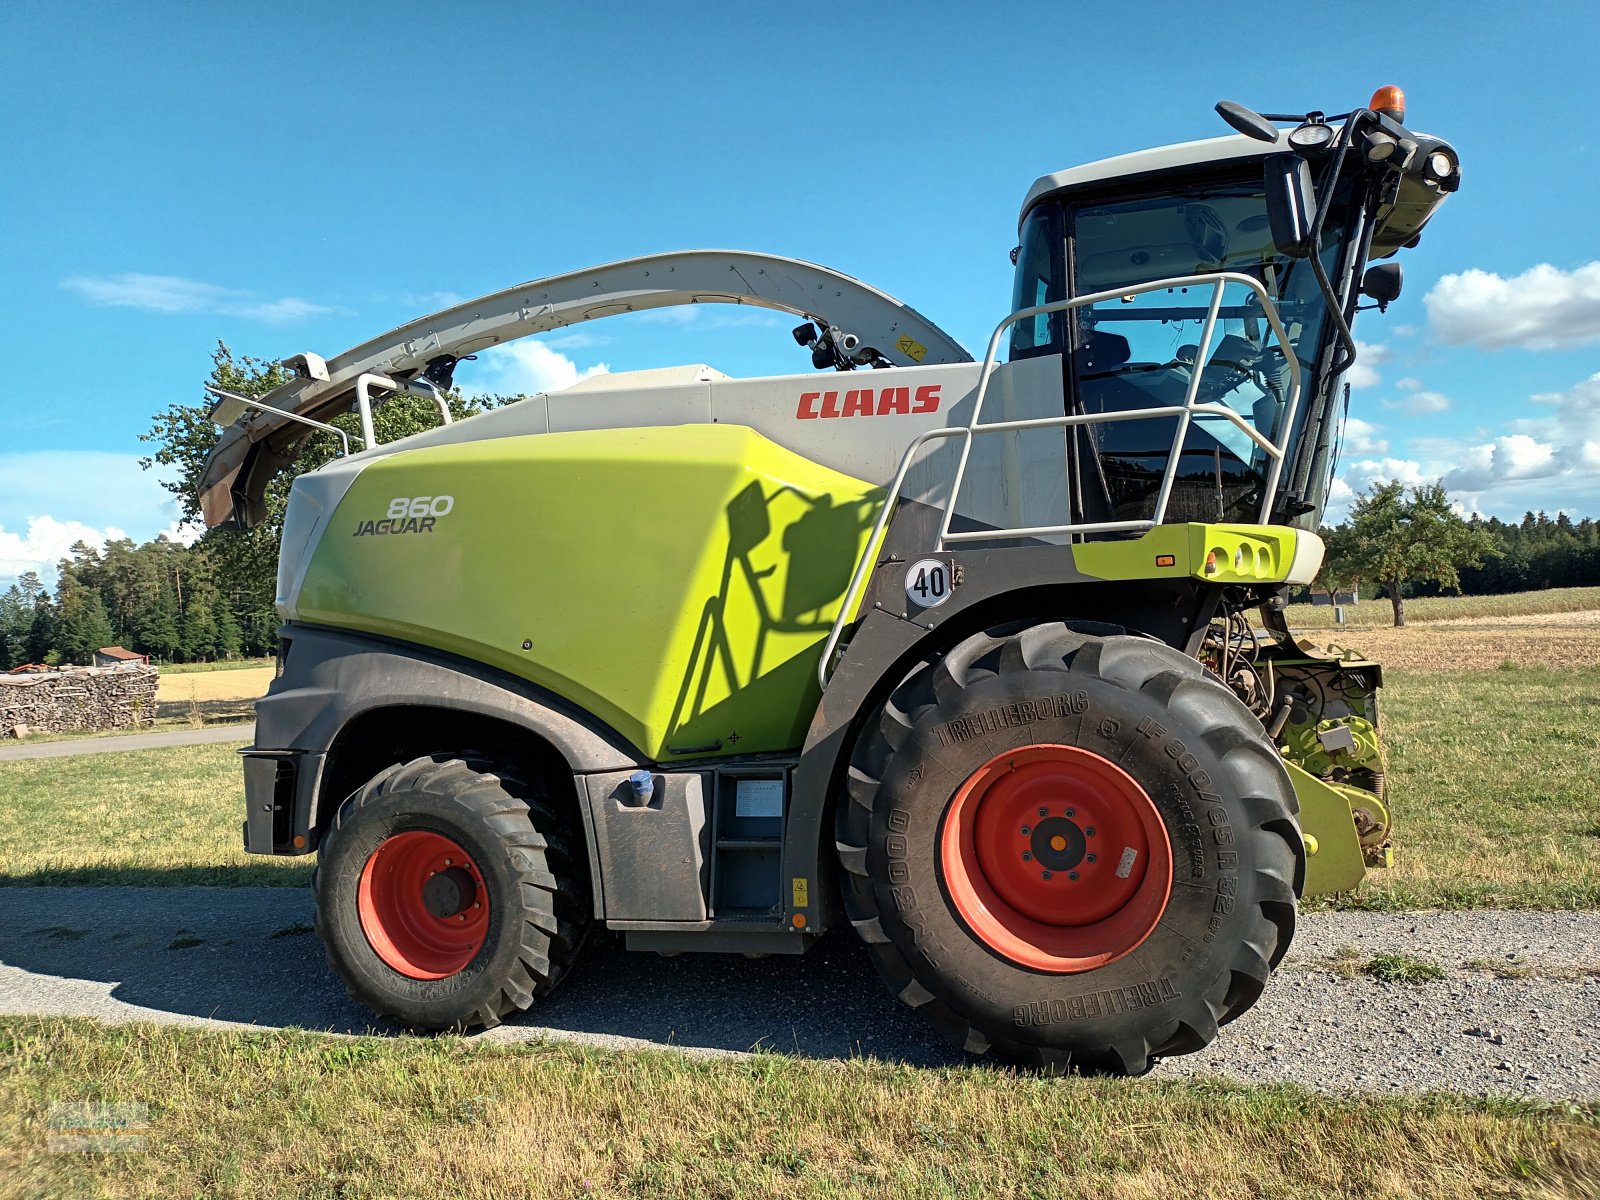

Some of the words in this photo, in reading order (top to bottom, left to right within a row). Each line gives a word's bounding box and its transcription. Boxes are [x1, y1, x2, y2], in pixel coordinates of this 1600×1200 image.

[796, 384, 941, 420] CLAAS
[386, 495, 454, 519] 860
[352, 516, 437, 536] JAGUAR
[914, 567, 945, 597] 40
[932, 690, 1089, 747] TRELLEBORG
[1165, 739, 1235, 845] 800/65
[1217, 851, 1238, 870] R
[1214, 876, 1238, 915] 32
[1012, 978, 1182, 1027] TRELLEBORG
